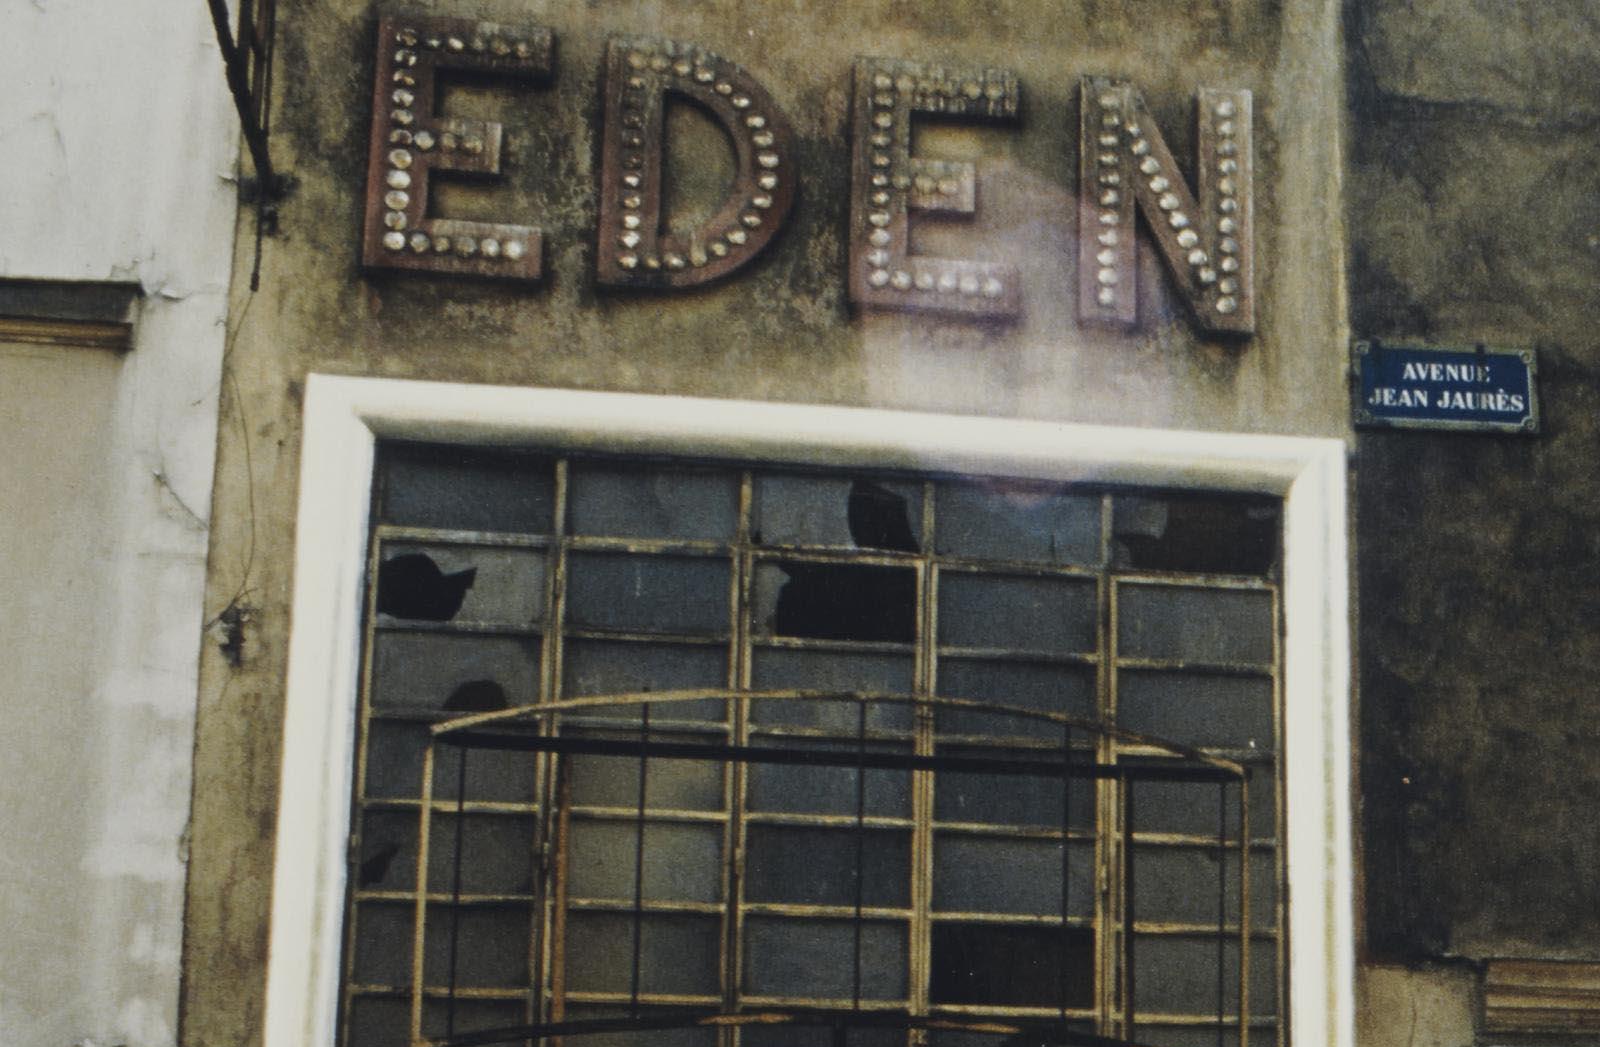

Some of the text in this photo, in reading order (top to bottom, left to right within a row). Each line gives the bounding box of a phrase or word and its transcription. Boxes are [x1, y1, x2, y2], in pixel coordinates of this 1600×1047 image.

[363, 14, 1254, 332] EDEN
[1402, 362, 1491, 384] AVENUE
[1368, 387, 1526, 413] JEAN JAURÈS
